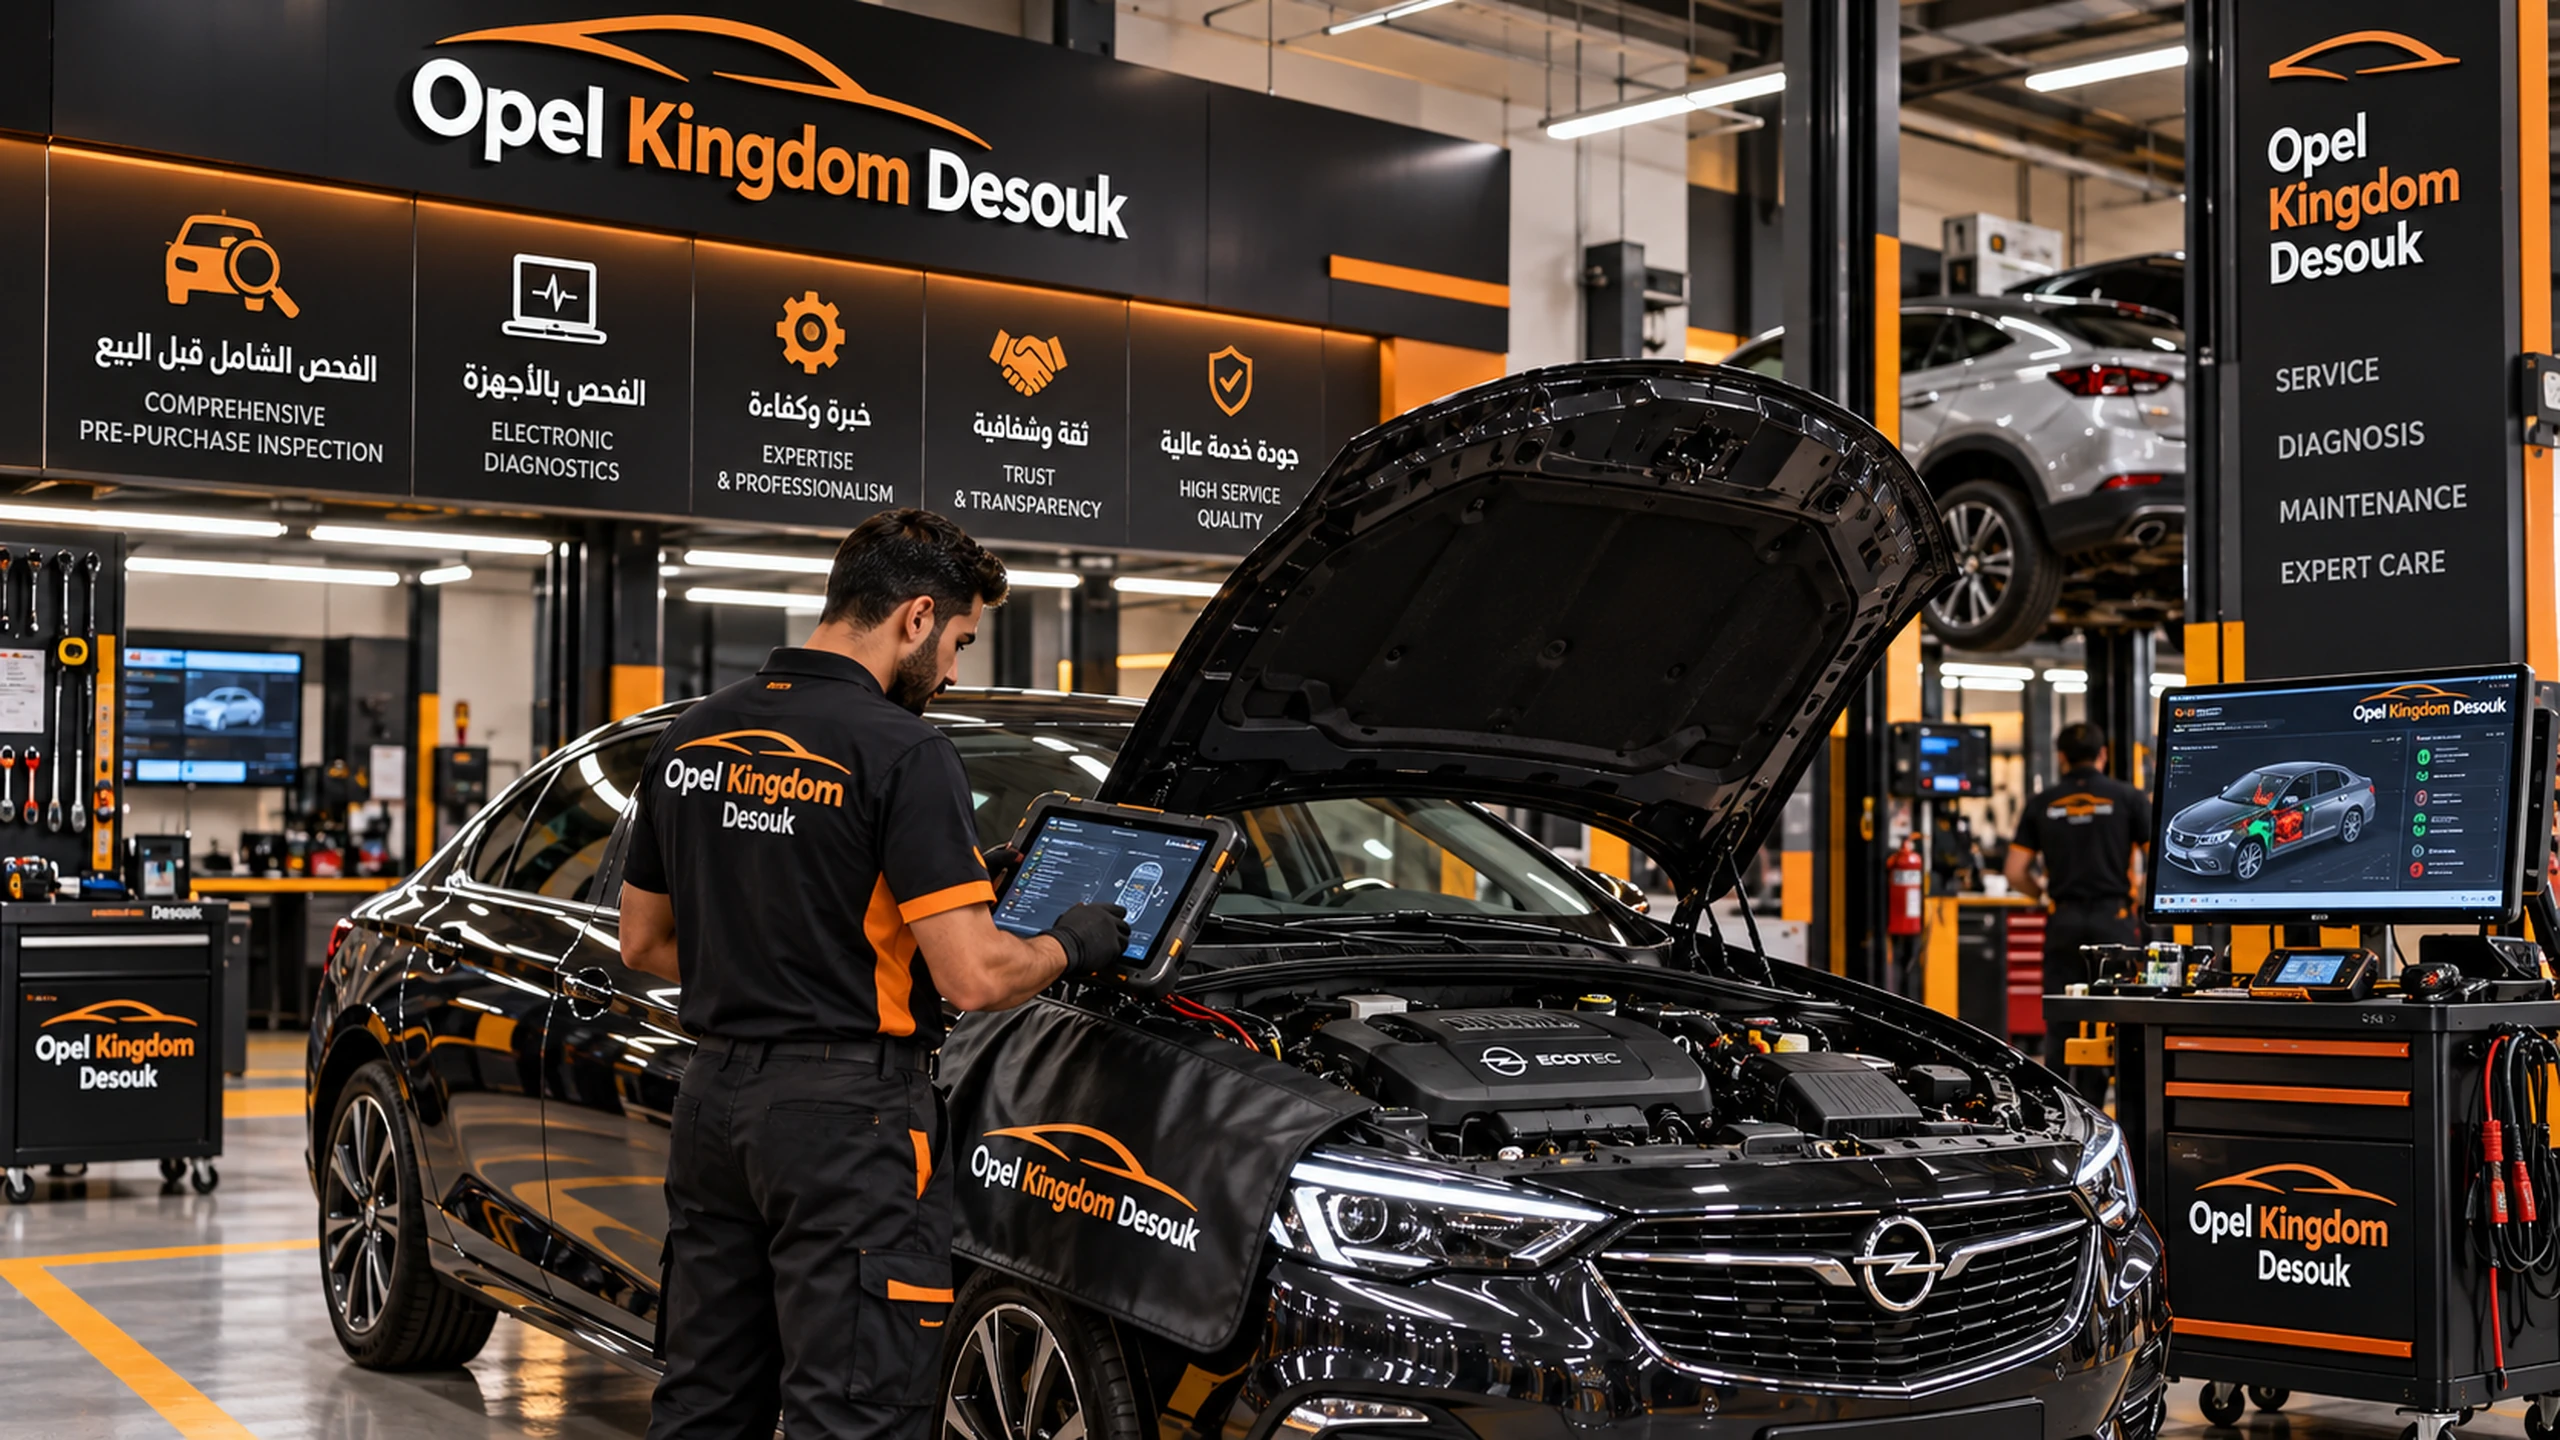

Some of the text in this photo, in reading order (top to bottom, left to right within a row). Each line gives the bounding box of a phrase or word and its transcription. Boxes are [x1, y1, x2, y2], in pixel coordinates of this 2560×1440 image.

[411, 57, 1130, 240] Opel Kingdom Desouk
[2267, 111, 2367, 179] Opel
[2269, 166, 2460, 232] Kingdom
[2269, 219, 2424, 285] Desouk
[95, 331, 377, 385] الفحص الشامل قبل البيع
[2275, 356, 2380, 393] SERVICE
[463, 362, 646, 409] الفحص بالأجهزة
[144, 391, 326, 427] COMPREHENSIVE
[748, 390, 872, 433] خبرة وكفاءة
[79, 419, 384, 464] PRE-PURCHASE INSPECTION
[492, 421, 614, 451] ELECTRONIC
[973, 411, 1090, 450] ثقة وشفافية
[2278, 420, 2425, 460] DIAGNOSIS
[484, 452, 620, 482] DIAGNOSTICS
[763, 444, 854, 471] EXPERTISE
[1160, 429, 1300, 472] جودة خدمة عالية
[717, 470, 894, 504] & PROFESSIONALISM
[1002, 464, 1056, 487] TRUST
[1179, 479, 1281, 506] HIGH SERVICE
[953, 489, 1103, 520] & TRANSPARENCY
[1197, 508, 1264, 532] QUALITY
[2279, 483, 2468, 524] MAINTENANCE
[2280, 549, 2446, 585] EXPERT CARE
[2352, 696, 2507, 724] Opel Kingdom Desouk
[664, 758, 845, 808] Opel Kingdom
[721, 800, 796, 836] Desouk
[35, 1031, 195, 1066] Opel Kingdom
[1534, 1052, 1622, 1067] ECOTEC
[80, 1063, 158, 1090] Desouk
[971, 1144, 1201, 1252] Opel Kingdom Desouk
[2189, 1200, 2389, 1251] Opel Kingdom
[2258, 1249, 2352, 1288] Desouk
